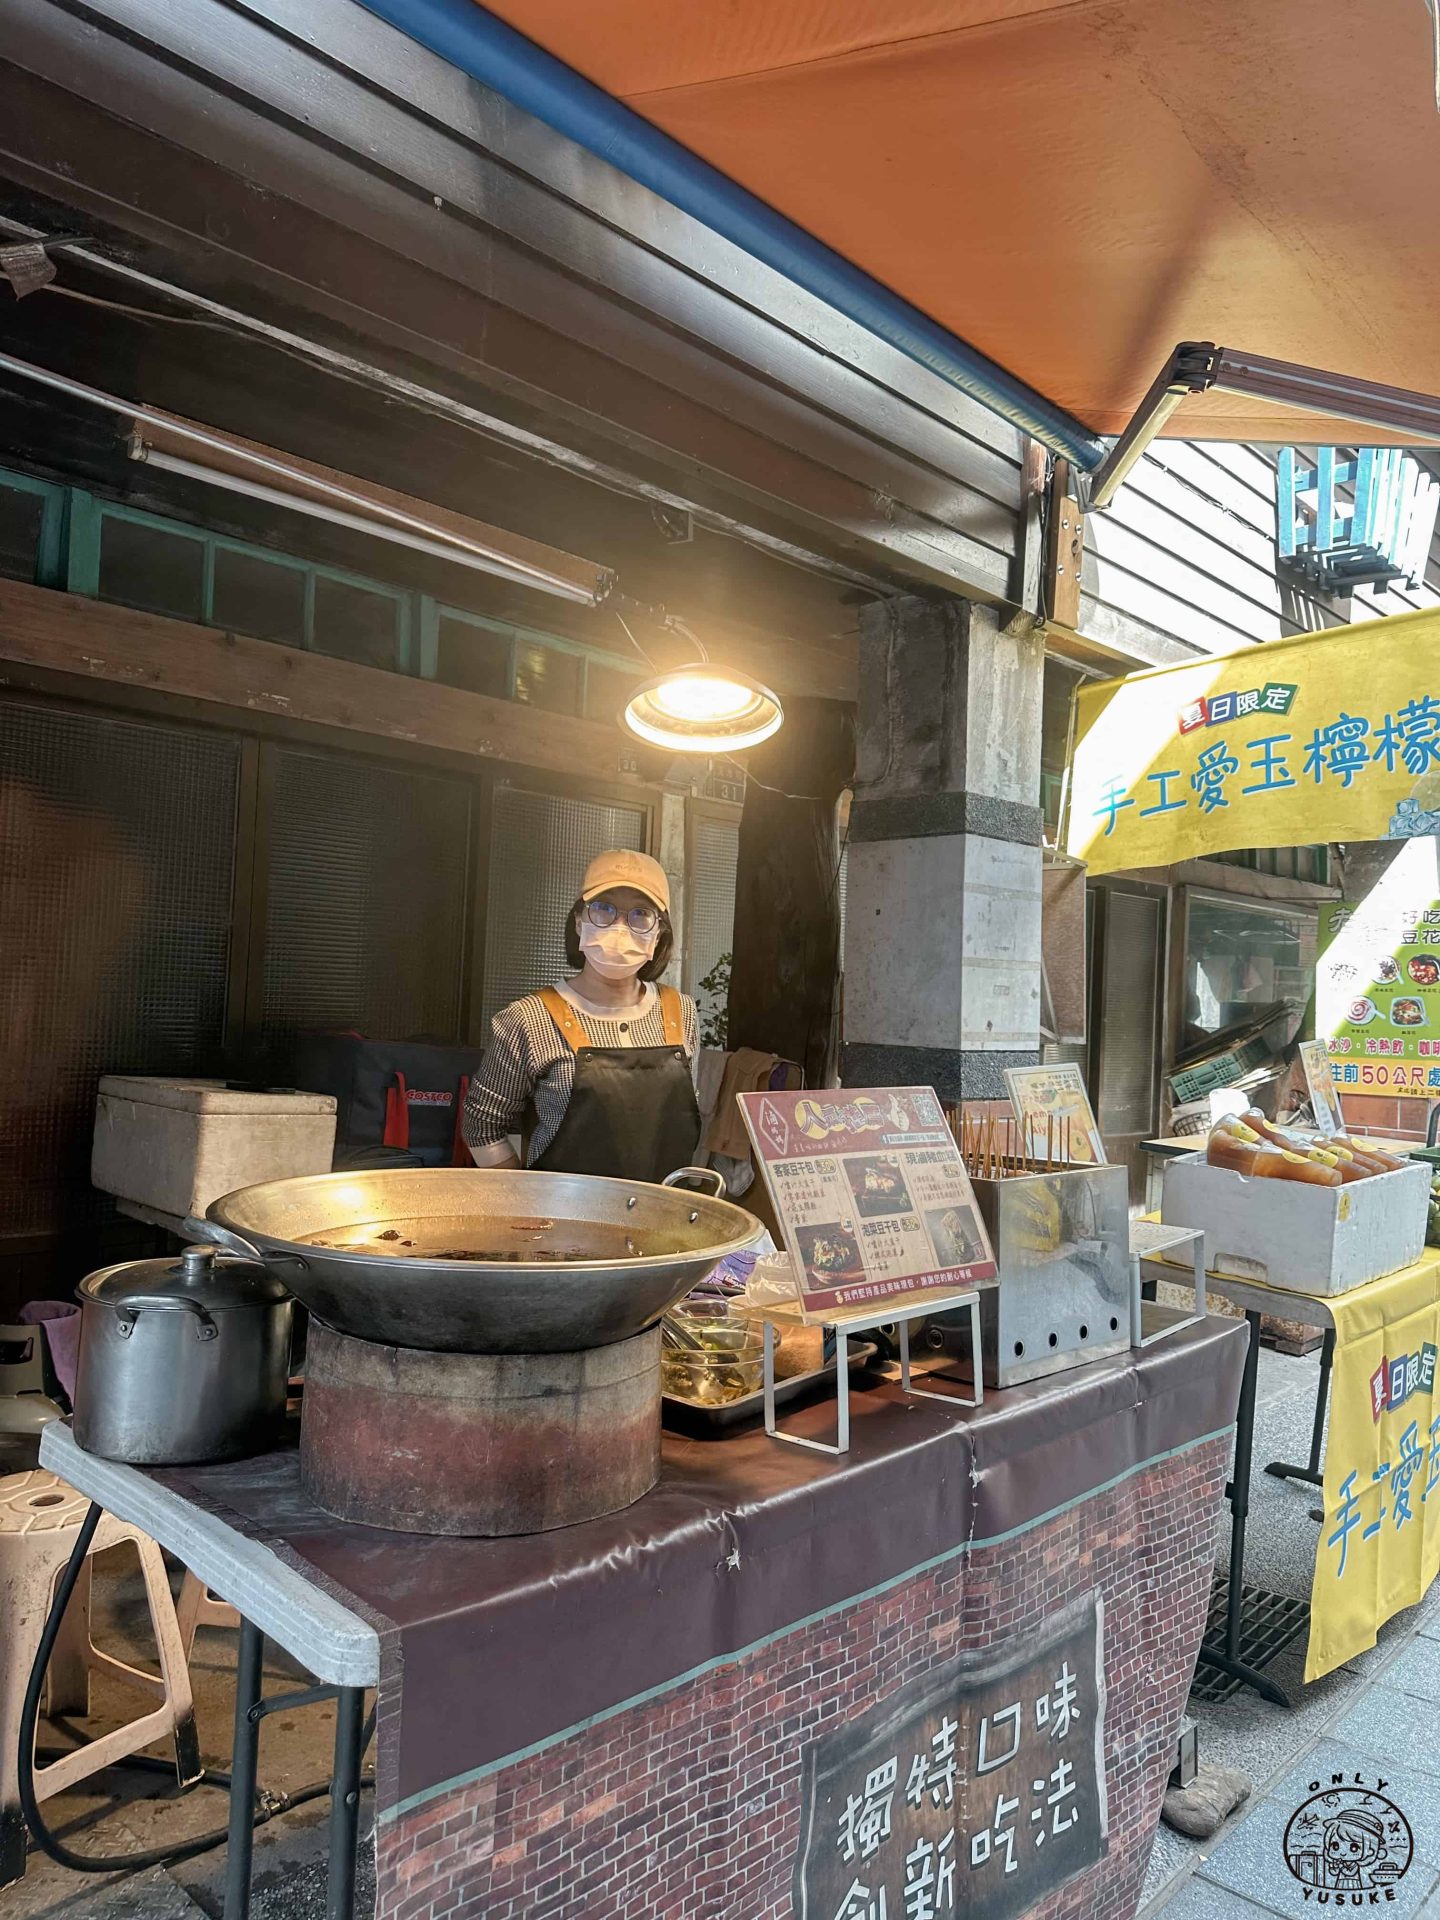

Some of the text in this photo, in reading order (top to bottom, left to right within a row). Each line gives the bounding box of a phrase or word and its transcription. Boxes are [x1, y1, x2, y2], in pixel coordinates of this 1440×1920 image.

[1180, 684, 1294, 730] 夏日限定
[1092, 694, 1440, 836] 手工愛玉檸檬
[406, 1089, 453, 1101] COSTCO
[1373, 1350, 1436, 1413] 夏日限定
[836, 1661, 1081, 1861] 獨特口味
